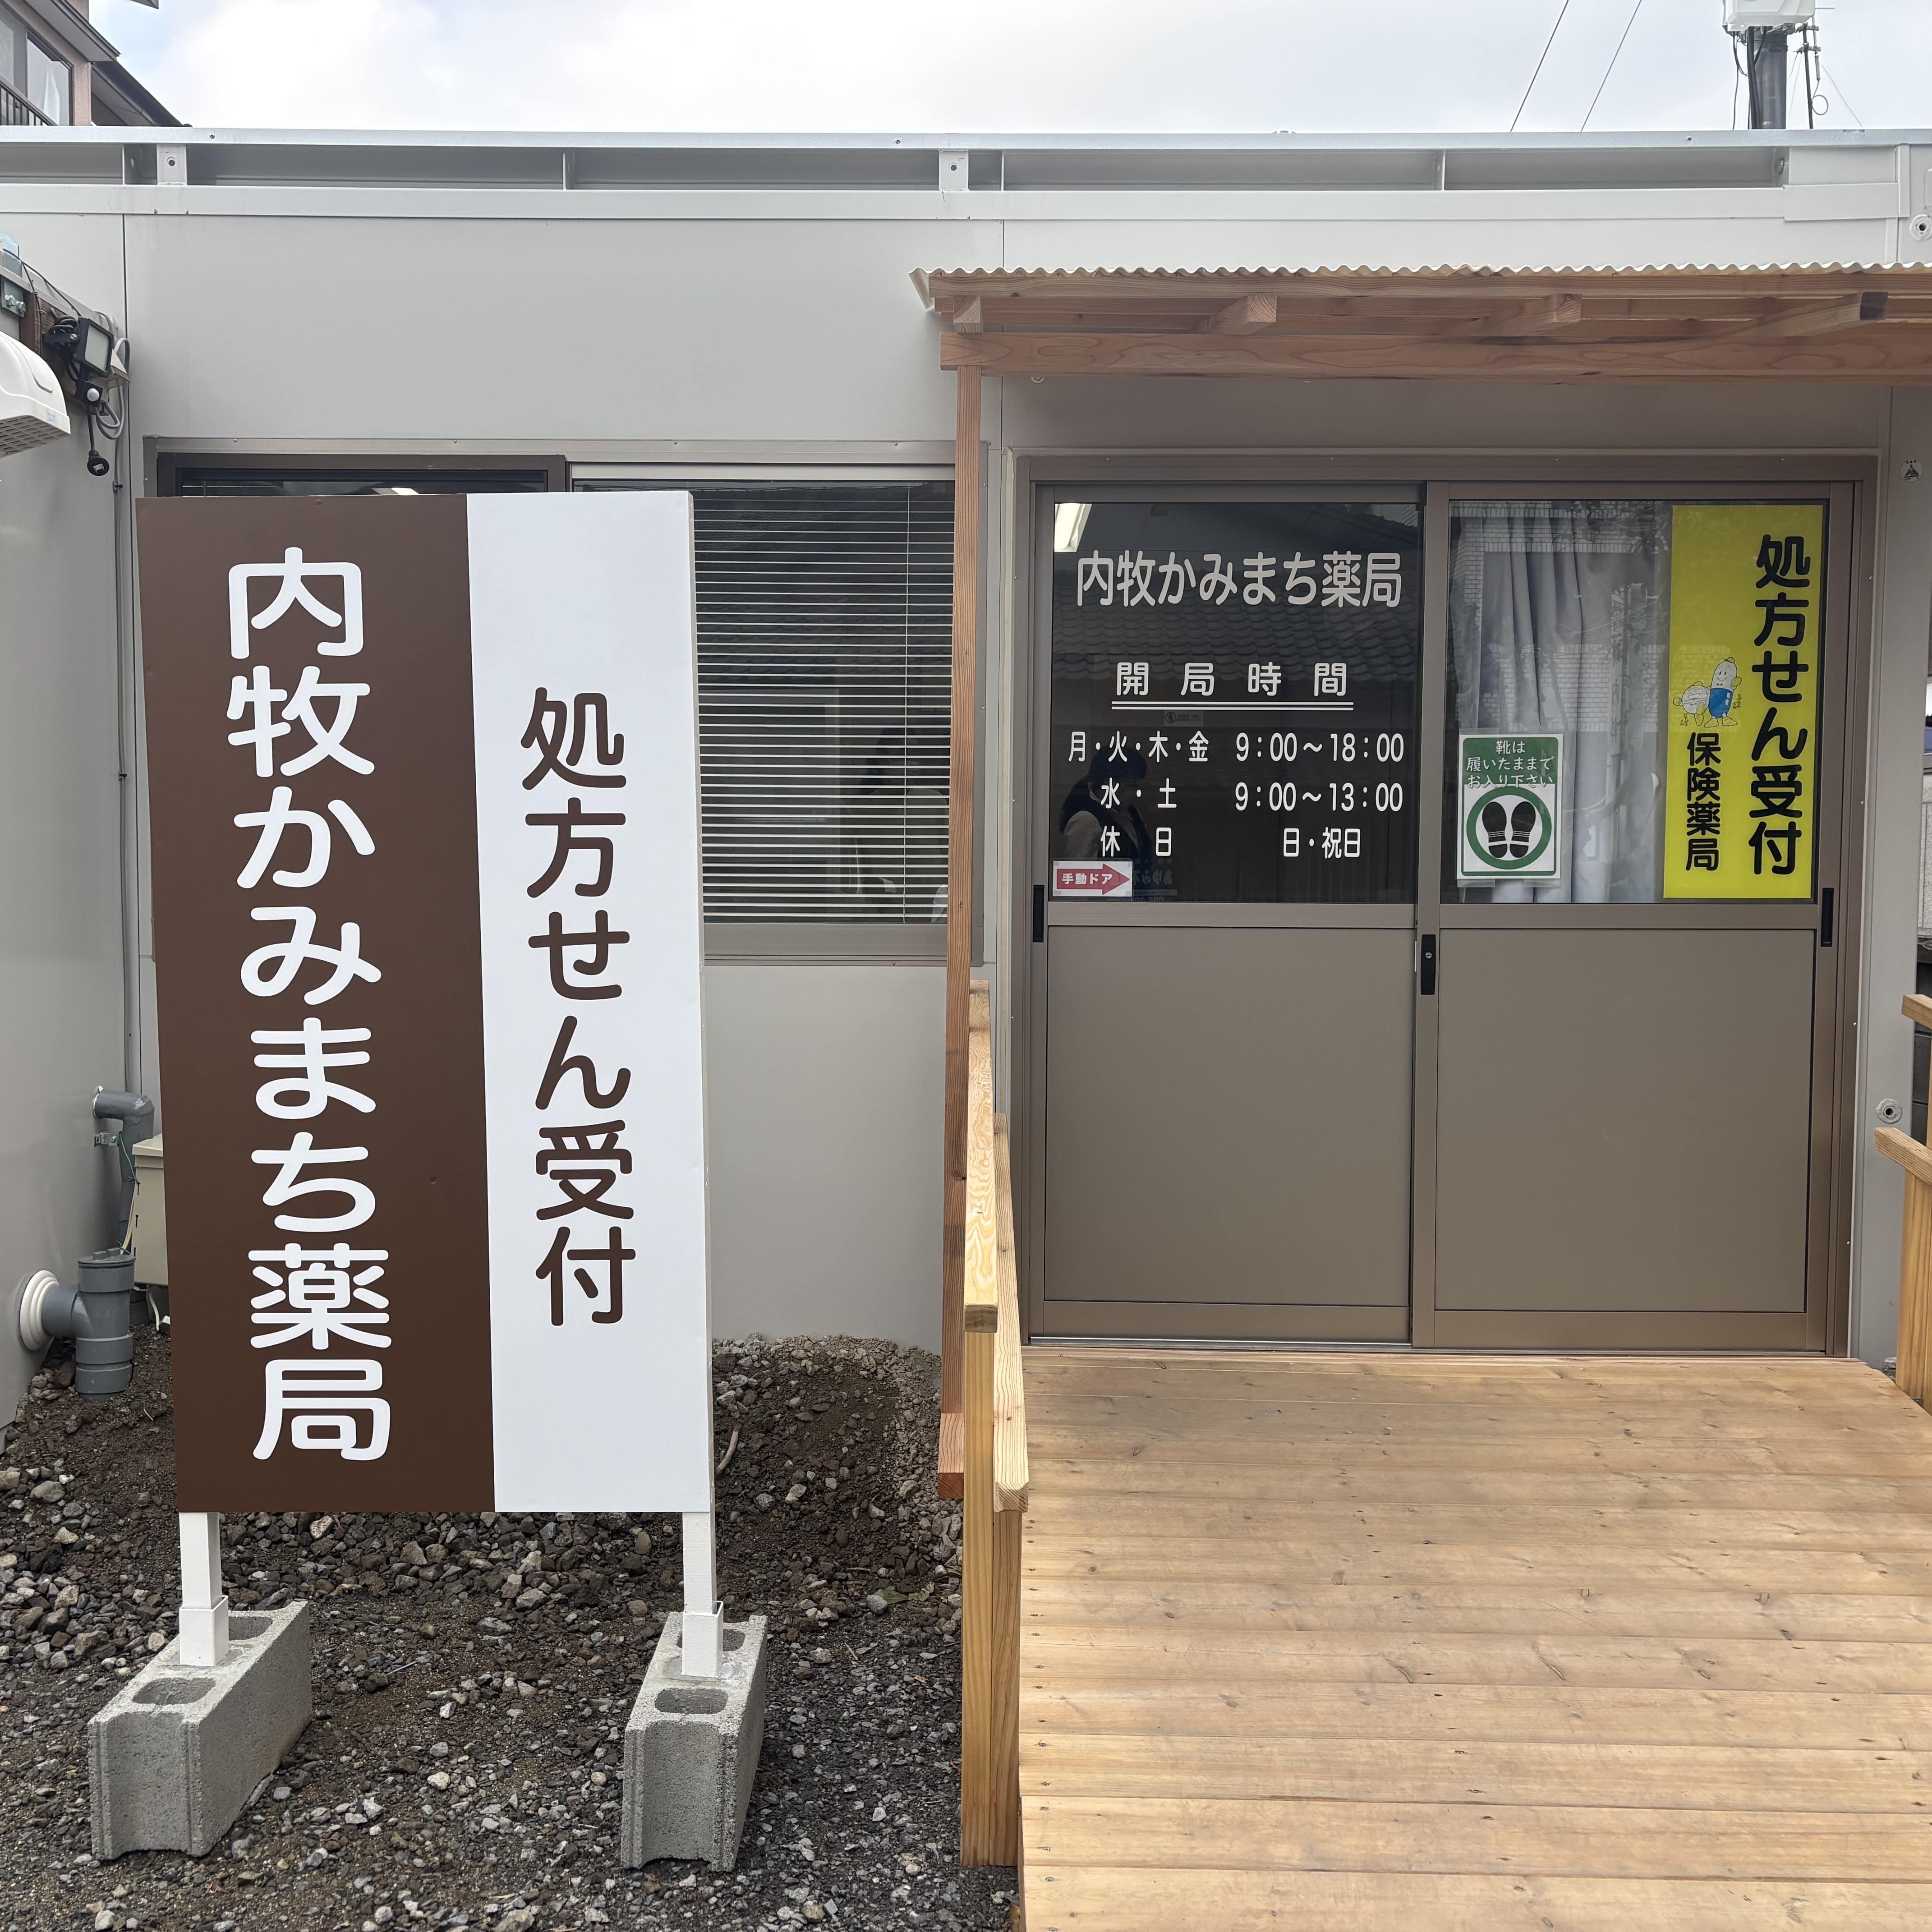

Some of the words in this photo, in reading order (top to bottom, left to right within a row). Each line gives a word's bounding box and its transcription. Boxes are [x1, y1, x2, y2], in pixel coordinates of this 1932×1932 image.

[1076, 550, 1401, 607] 内牧かみまち薬局
[1117, 662, 1346, 696] 開局時間
[1748, 534, 1811, 875] 処方せん受付
[1467, 756, 1555, 772] 履いたままで
[1495, 740, 1526, 754] 靴は
[1467, 774, 1553, 788] お入り下さい
[1686, 732, 1721, 870] 保険薬局
[1062, 873, 1113, 885] 手動ドア
[227, 547, 391, 1460] 内牧かみまち薬局
[521, 687, 635, 1326] 処方せん受付
